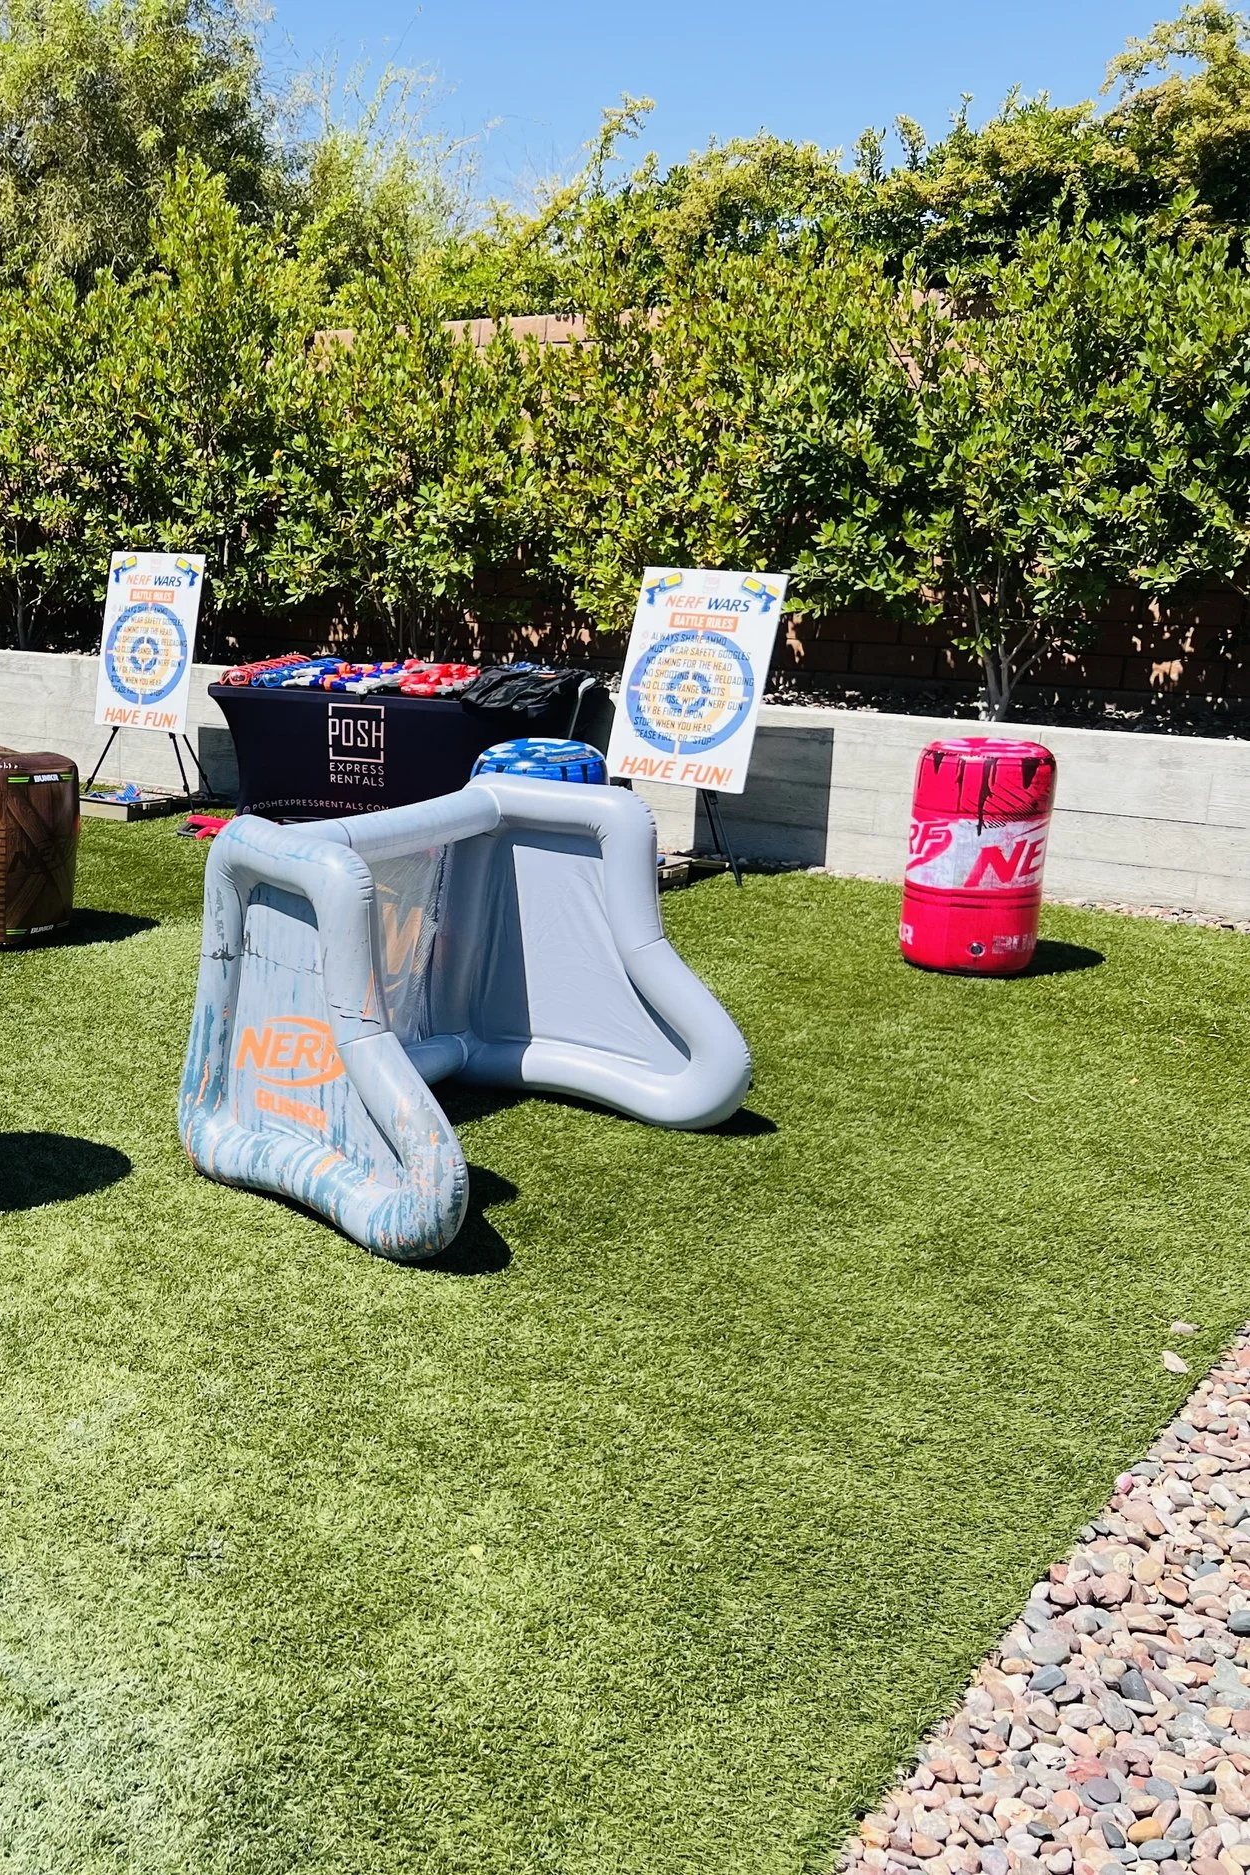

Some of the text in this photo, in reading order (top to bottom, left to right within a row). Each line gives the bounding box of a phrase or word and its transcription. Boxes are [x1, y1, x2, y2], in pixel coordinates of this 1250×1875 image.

[127, 575, 182, 587] NERF WARS
[665, 595, 751, 612] NERF WARS
[673, 615, 734, 630] BATTLE RULES
[706, 636, 727, 646] AMMO
[649, 645, 752, 661] MUST WEAR SAFETY GOGGLES
[645, 656, 733, 672] NO AIMING FOR THE HEAD
[644, 668, 754, 687] NO SHOOTING WHILE RELOADING
[641, 681, 651, 689] NO
[701, 686, 726, 697] SHOTS
[636, 705, 651, 714] MAY
[652, 706, 661, 715] BE
[639, 693, 656, 702] ONLY
[658, 694, 680, 704] THOSE
[707, 699, 727, 710] NERF
[727, 701, 744, 711] GUN
[104, 707, 178, 729] HAVE FUN!
[655, 719, 676, 729] WHEN
[677, 721, 691, 730] YOU
[328, 718, 385, 749] POSH
[678, 734, 688, 743] OR
[329, 762, 385, 775] EXPRESS
[619, 755, 734, 786] HAVE FUN!
[330, 774, 385, 787] RENTALS
[255, 1088, 328, 1131] BUNKR
